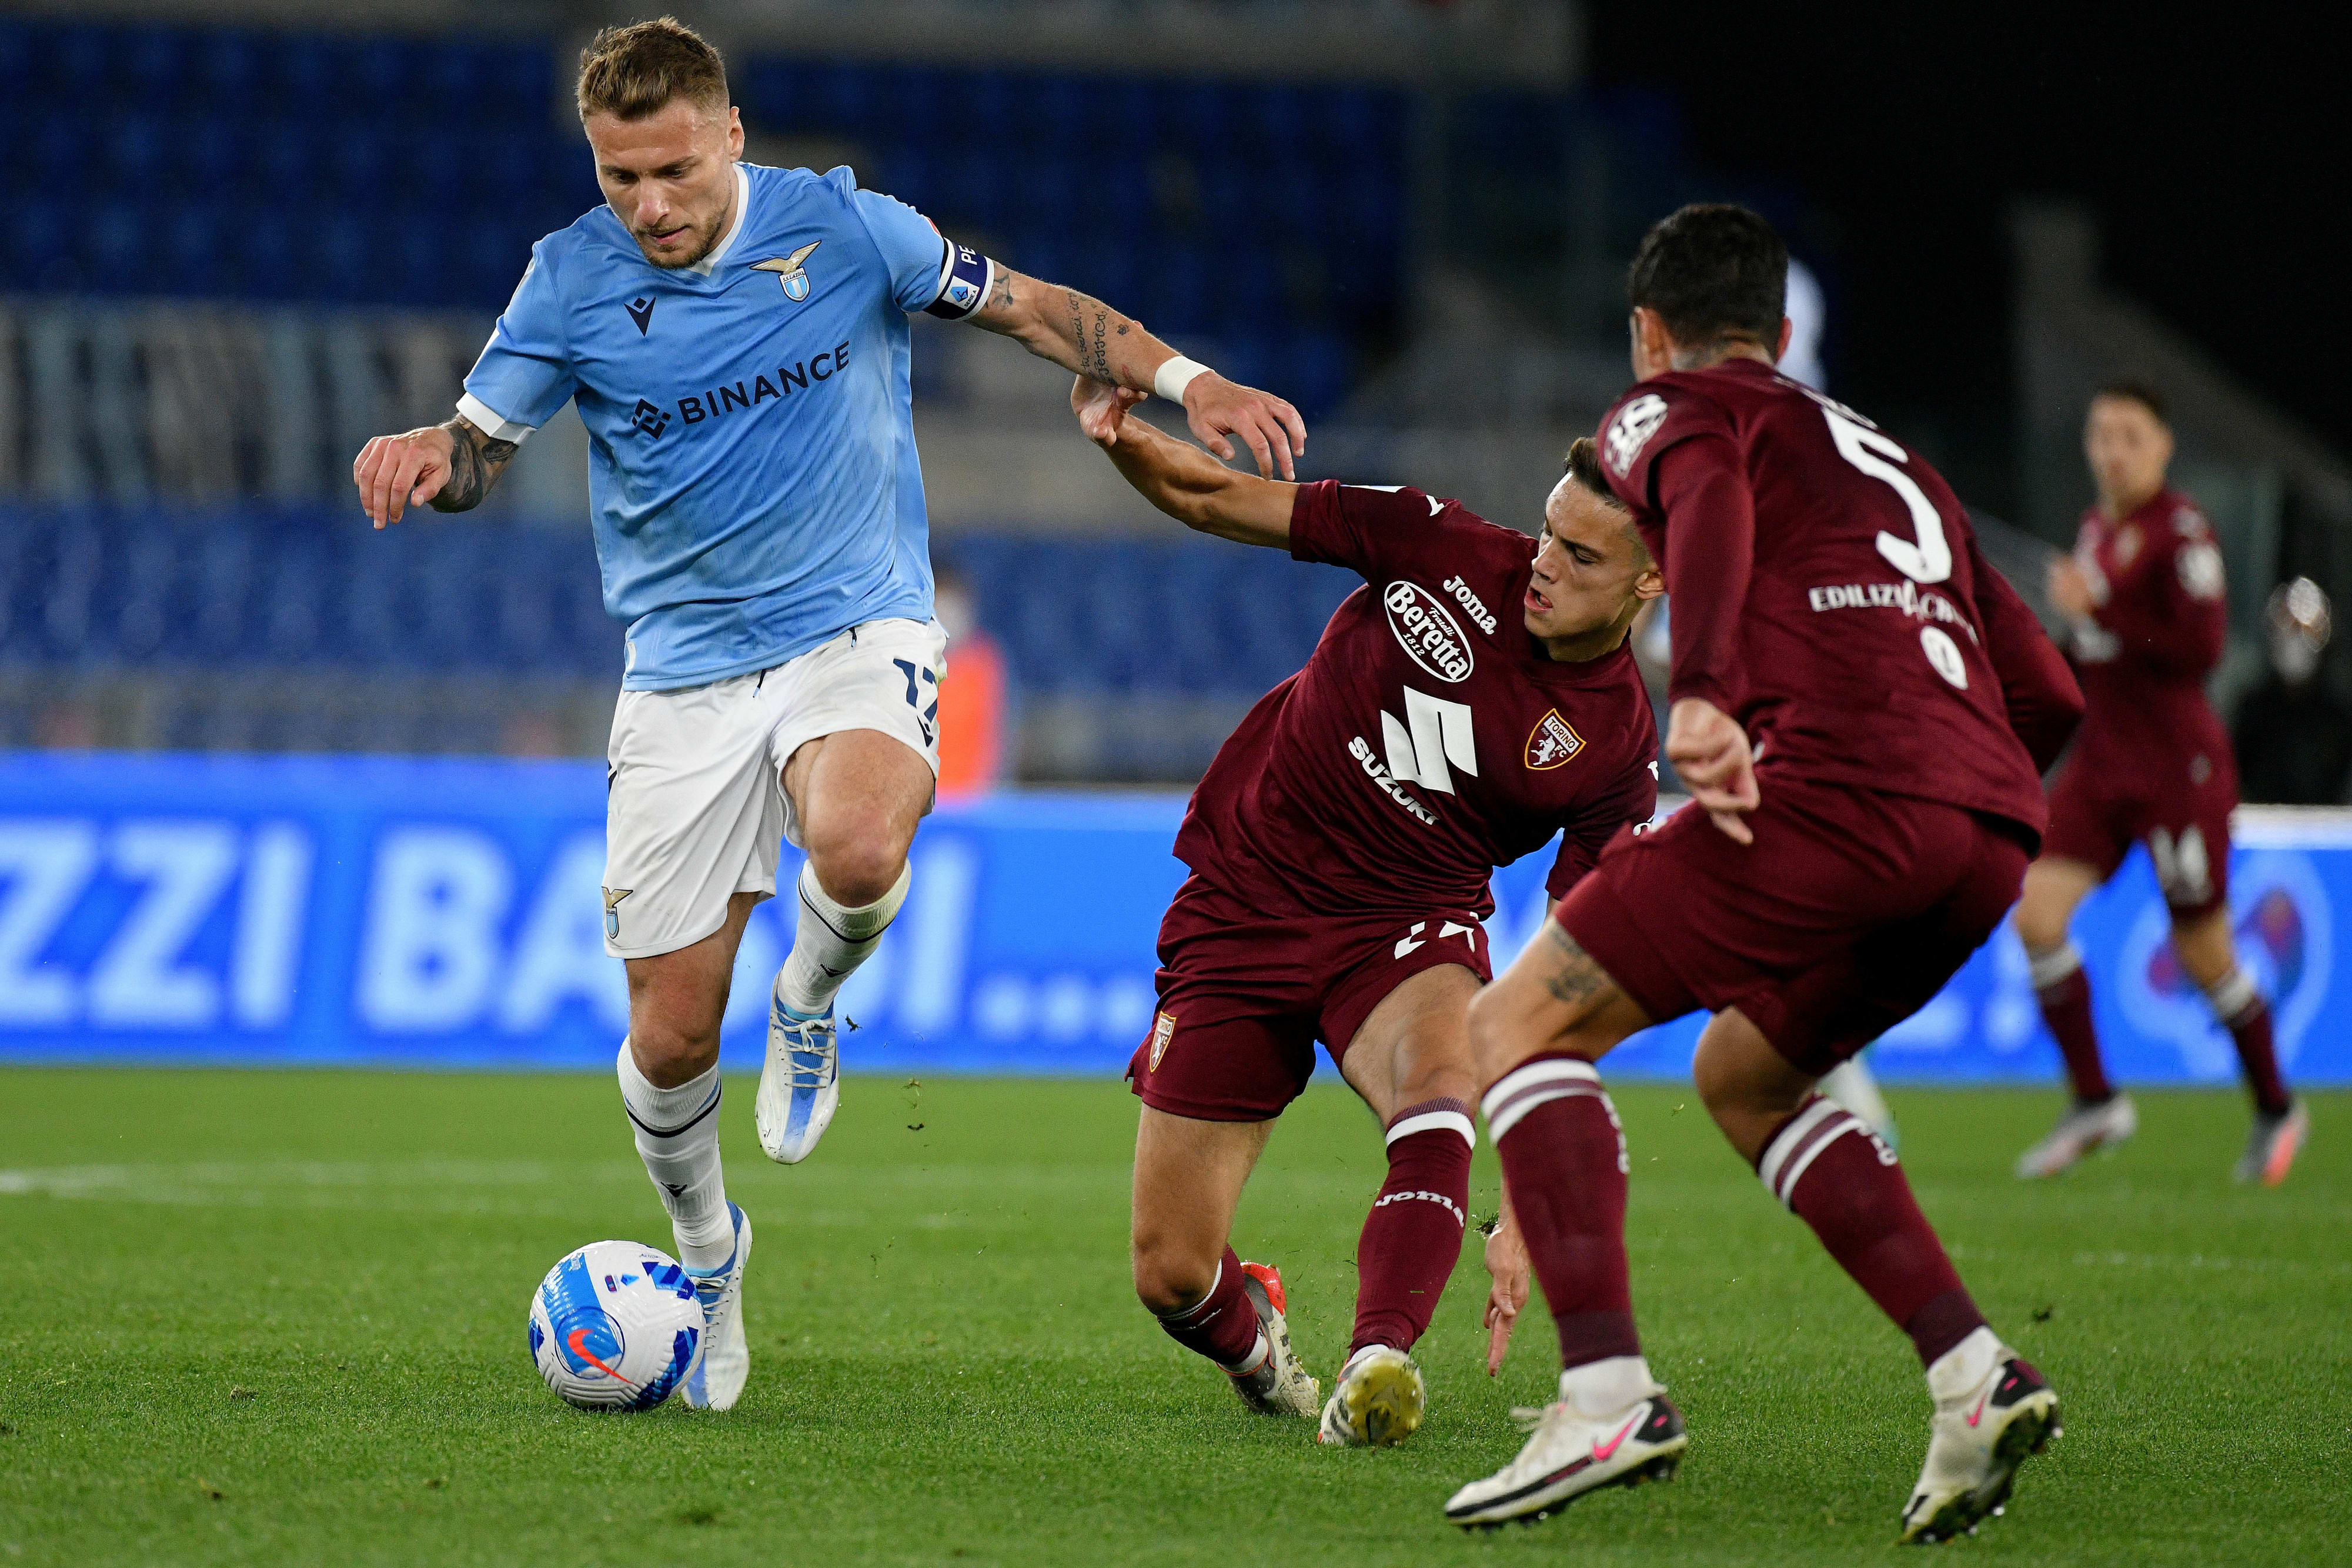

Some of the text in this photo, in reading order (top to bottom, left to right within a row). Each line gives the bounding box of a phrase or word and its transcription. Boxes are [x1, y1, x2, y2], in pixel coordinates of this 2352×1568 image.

[964, 293, 975, 307] SERIE
[677, 340, 850, 425] BINANCE
[1820, 406, 1952, 584] 5
[1428, 607, 1455, 637] Fratelli
[1443, 575, 1497, 635] Joma
[1386, 582, 1468, 681] Beretta
[1402, 633, 1425, 656] 1812
[1548, 718, 1575, 748] TORINO
[1553, 744, 1567, 758] FC
[1348, 736, 1439, 825] SUZUKI
